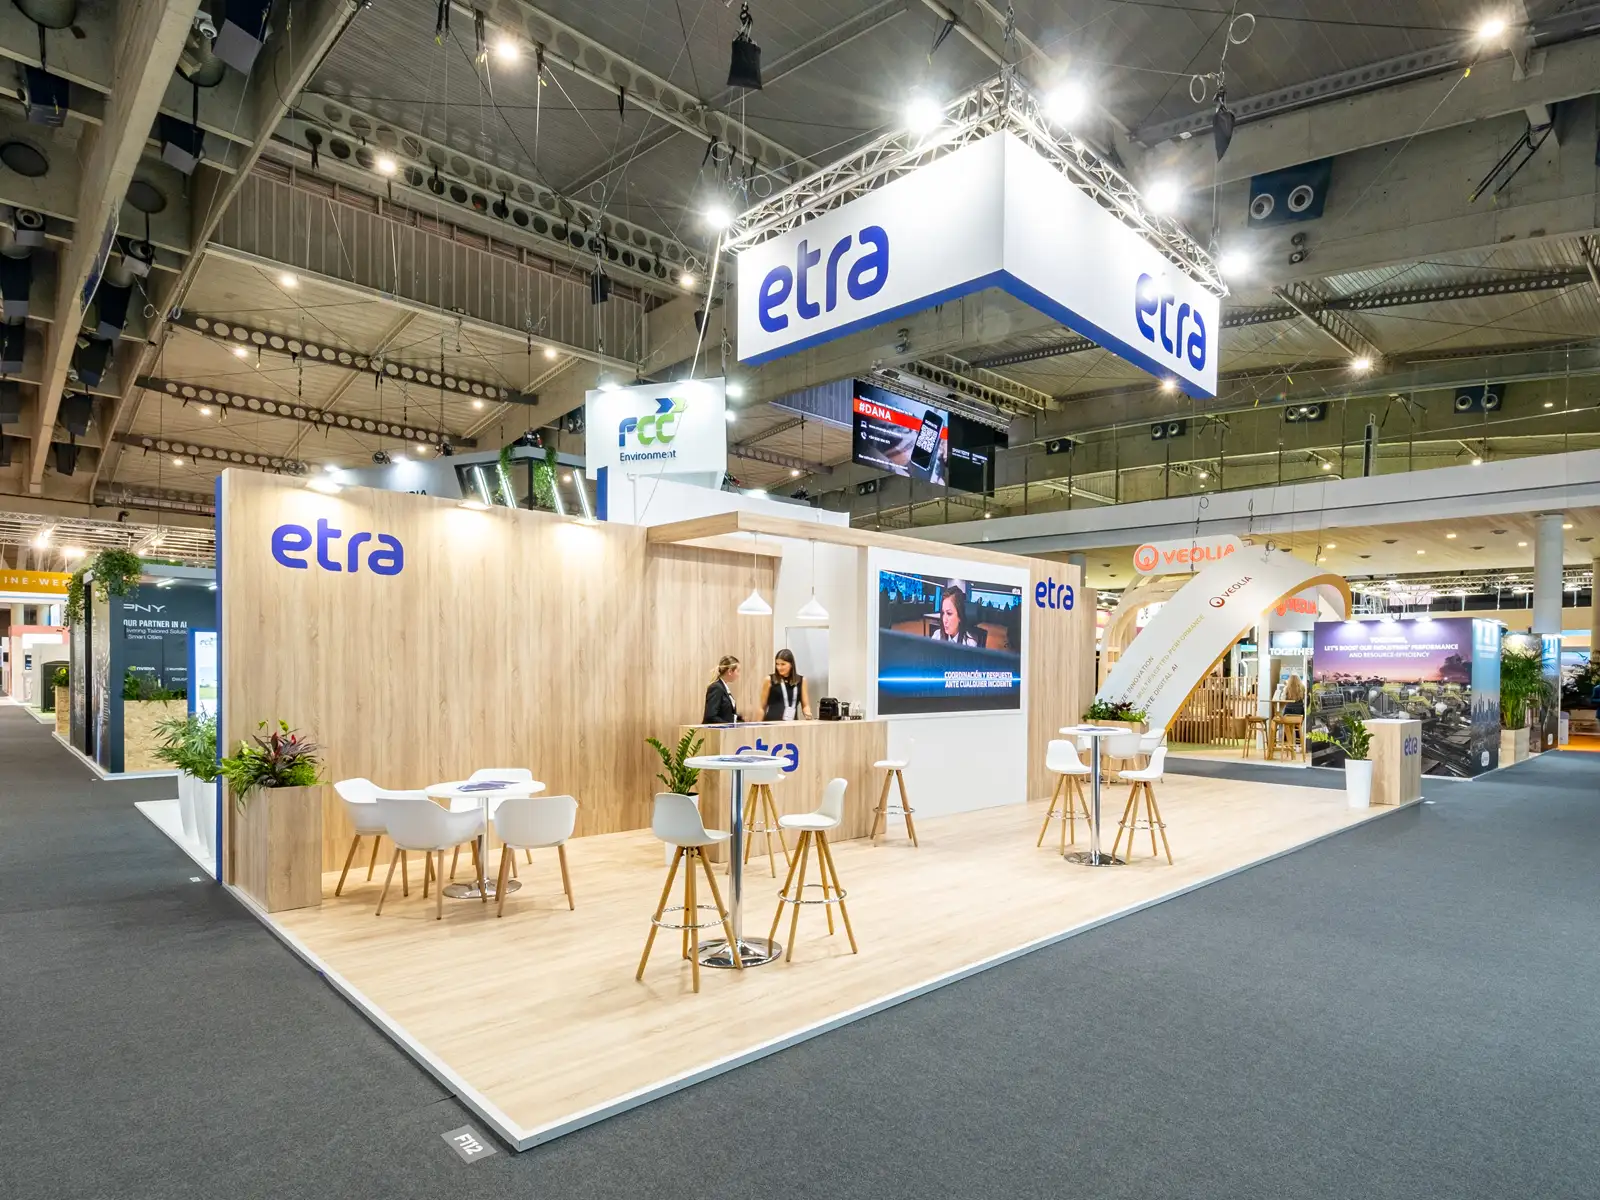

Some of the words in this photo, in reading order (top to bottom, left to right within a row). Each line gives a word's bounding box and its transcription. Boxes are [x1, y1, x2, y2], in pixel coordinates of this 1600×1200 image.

[758, 224, 889, 333] etra
[1134, 272, 1207, 372] etra
[858, 401, 892, 421] #DANA
[619, 449, 677, 462] Environment
[271, 518, 404, 576] etra
[1035, 576, 1074, 611] etra
[1222, 576, 1252, 598] VEOLIA
[139, 620, 170, 628] PARTNER
[1168, 613, 1206, 657] PERFORMANCE
[1411, 643, 1459, 651] PERFORMANCE
[945, 680, 959, 688] ANTE
[1126, 656, 1155, 694] INNOVATION
[1153, 672, 1173, 696] DIGITAL
[1171, 663, 1179, 672] AI
[1404, 734, 1418, 756] etra
